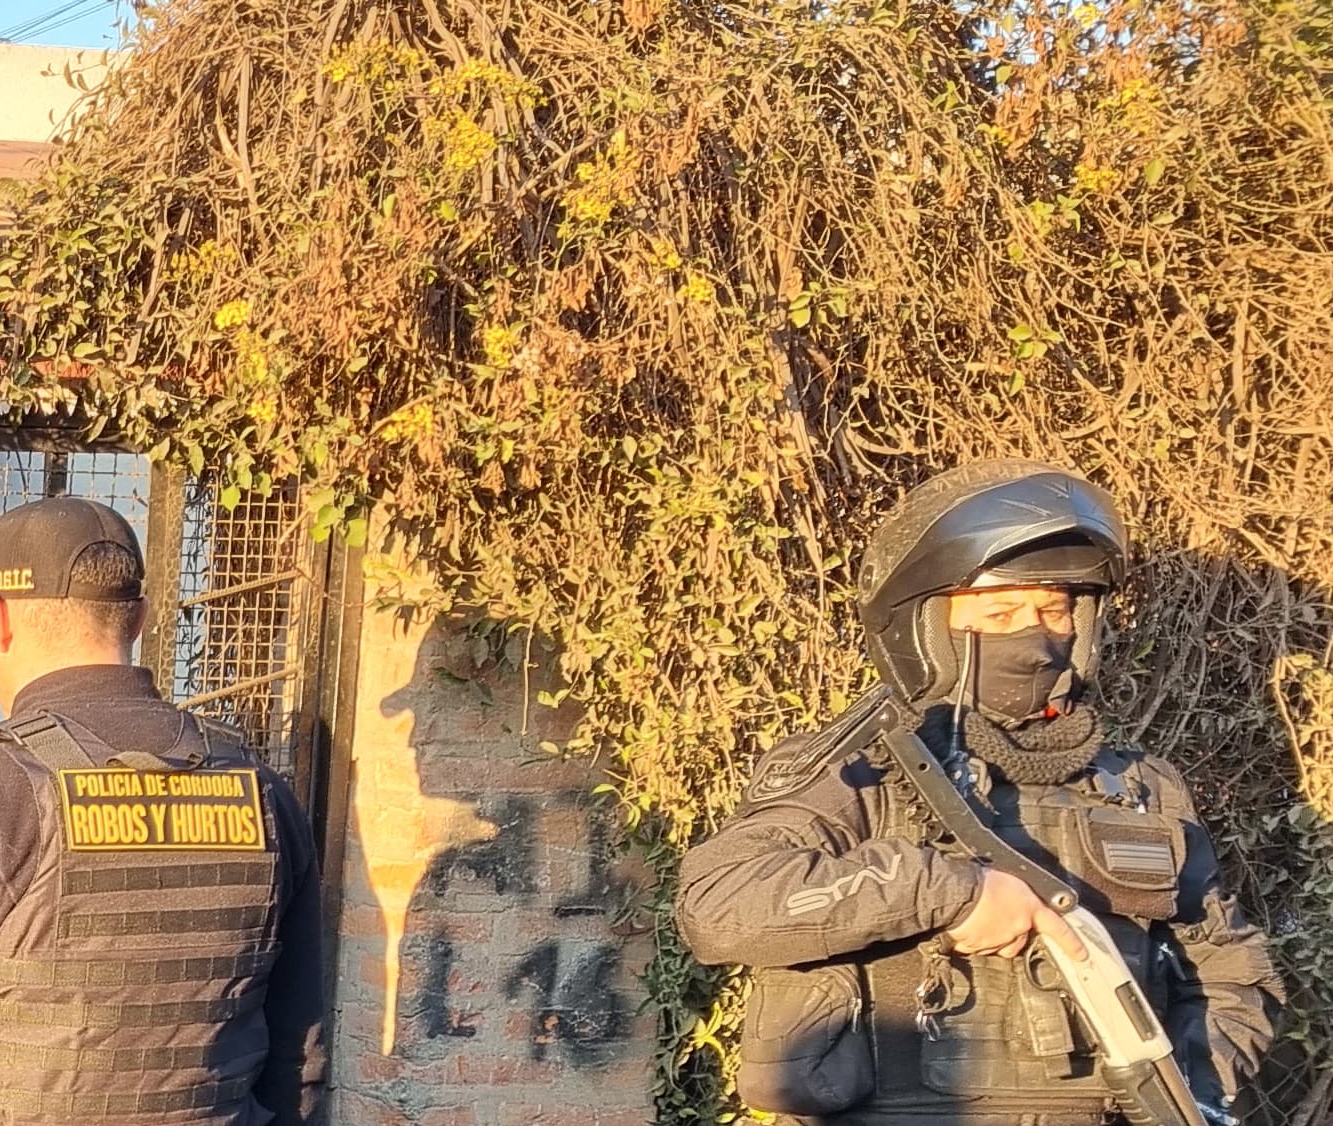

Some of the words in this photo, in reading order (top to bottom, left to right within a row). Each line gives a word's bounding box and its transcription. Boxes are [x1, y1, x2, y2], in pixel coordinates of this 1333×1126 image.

[75, 774, 143, 797] POLICIA
[144, 774, 168, 796] DE
[169, 774, 245, 798] CORDOBA
[72, 804, 149, 844] ROBOS
[150, 804, 166, 842] Y
[171, 804, 256, 844] HURTOS
